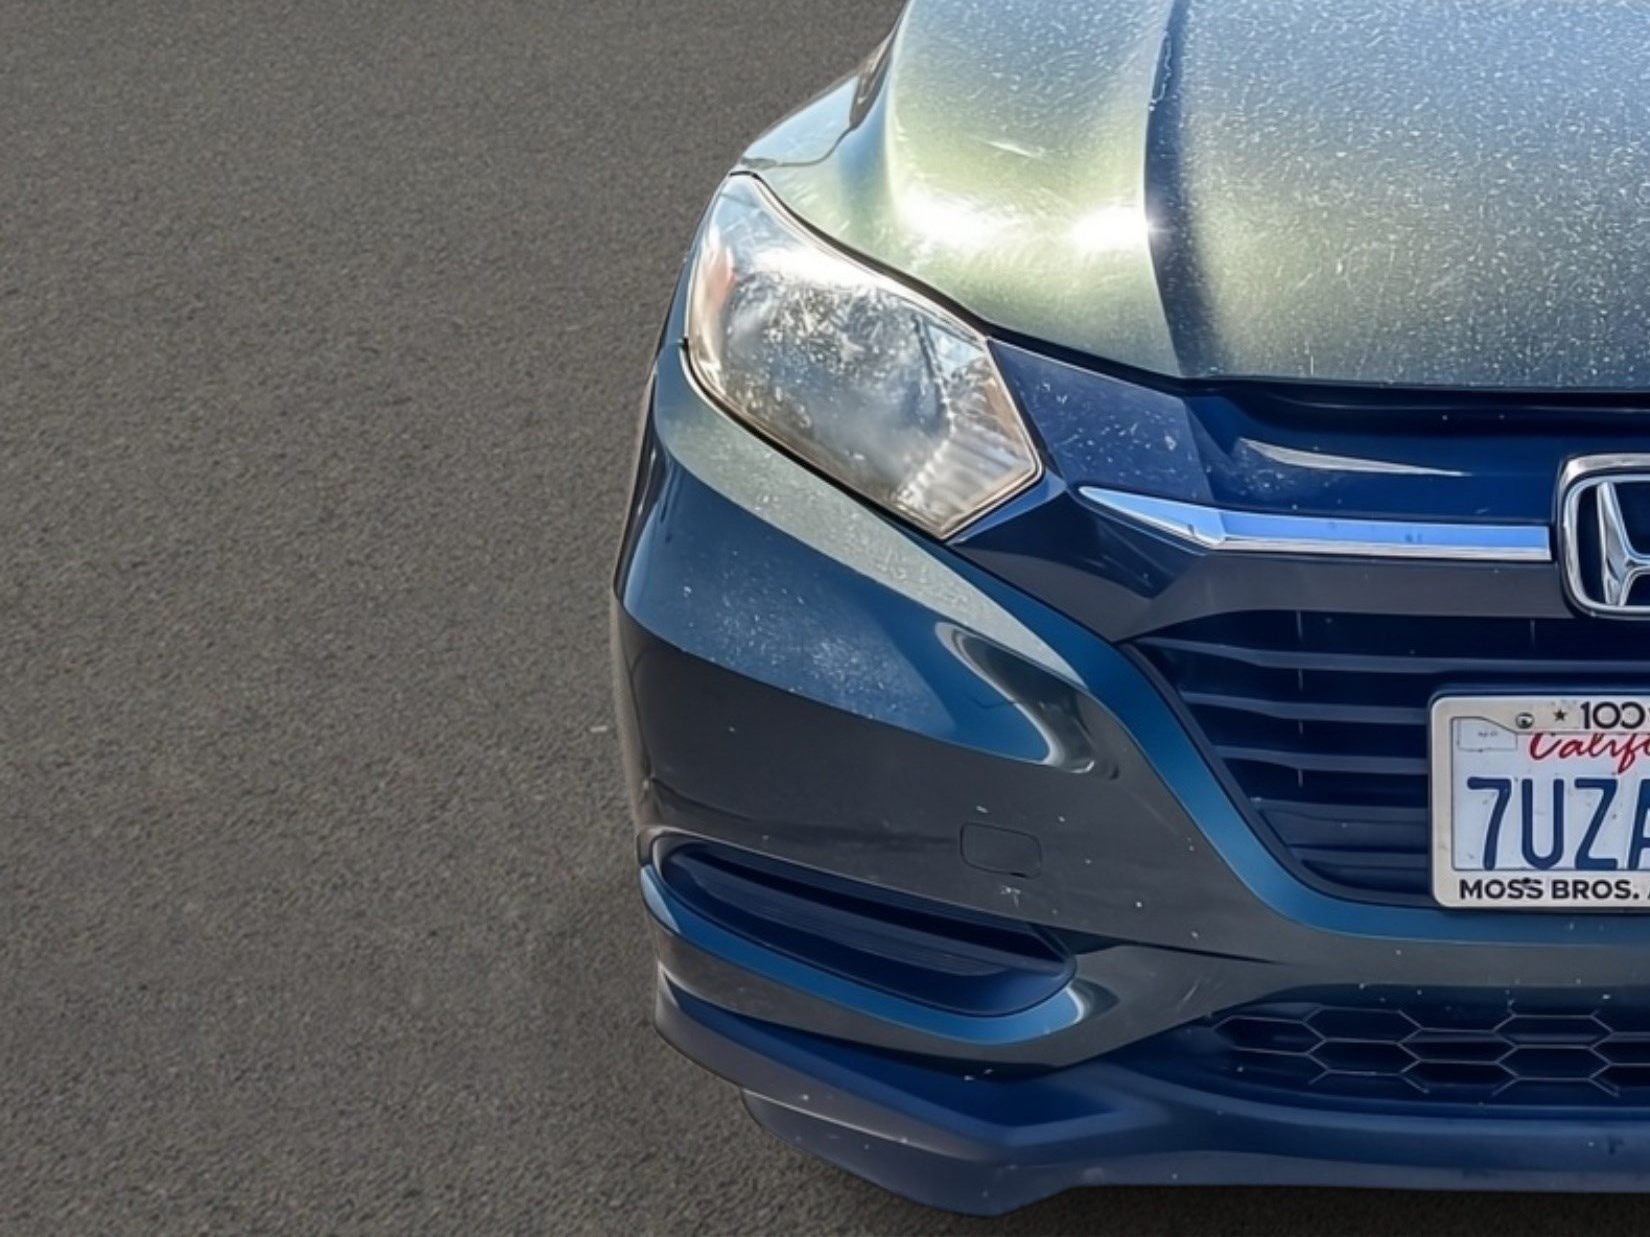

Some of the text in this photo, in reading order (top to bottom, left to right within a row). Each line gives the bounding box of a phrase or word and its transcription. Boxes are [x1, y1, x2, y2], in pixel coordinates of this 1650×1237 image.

[1580, 701, 1646, 730] 100
[1459, 877, 1544, 900] MOSS
[1551, 879, 1640, 900] BROS.
